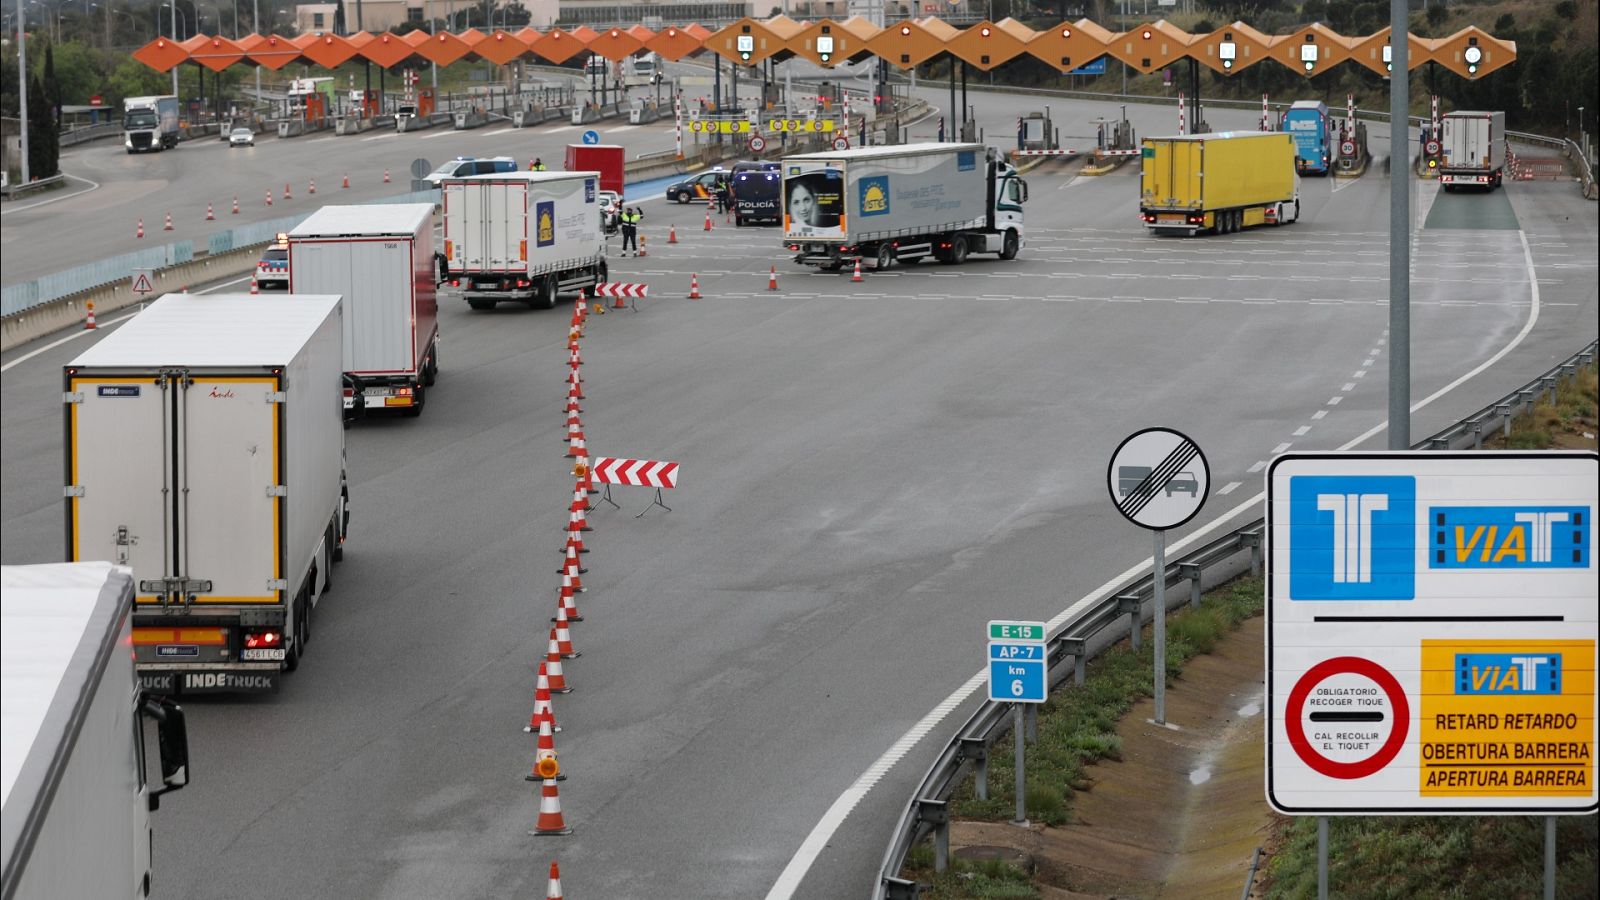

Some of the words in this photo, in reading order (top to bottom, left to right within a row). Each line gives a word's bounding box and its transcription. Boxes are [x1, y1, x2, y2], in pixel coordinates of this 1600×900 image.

[836, 141, 845, 149] 30
[1317, 493, 1389, 583] T
[999, 646, 1034, 658] AP-7
[1008, 665, 1025, 675] km
[185, 673, 272, 689] INDETRUCK
[1011, 679, 1024, 696] 6
[1316, 688, 1378, 696] OBLIGATORIO
[1310, 698, 1353, 706] RECOGER
[1357, 698, 1384, 706] TIQUE
[1436, 713, 1499, 730] RETARD
[1504, 713, 1577, 730] RETARDO
[1314, 732, 1332, 740] CAL
[1336, 732, 1379, 740] RECOLLIR
[1323, 742, 1333, 750] EL
[1338, 742, 1370, 750] TIQUET
[1422, 743, 1509, 760] OBERTURA
[1514, 742, 1590, 759] BARRERA
[1425, 770, 1509, 787] APERTURA
[1513, 770, 1586, 786] BARRERA
